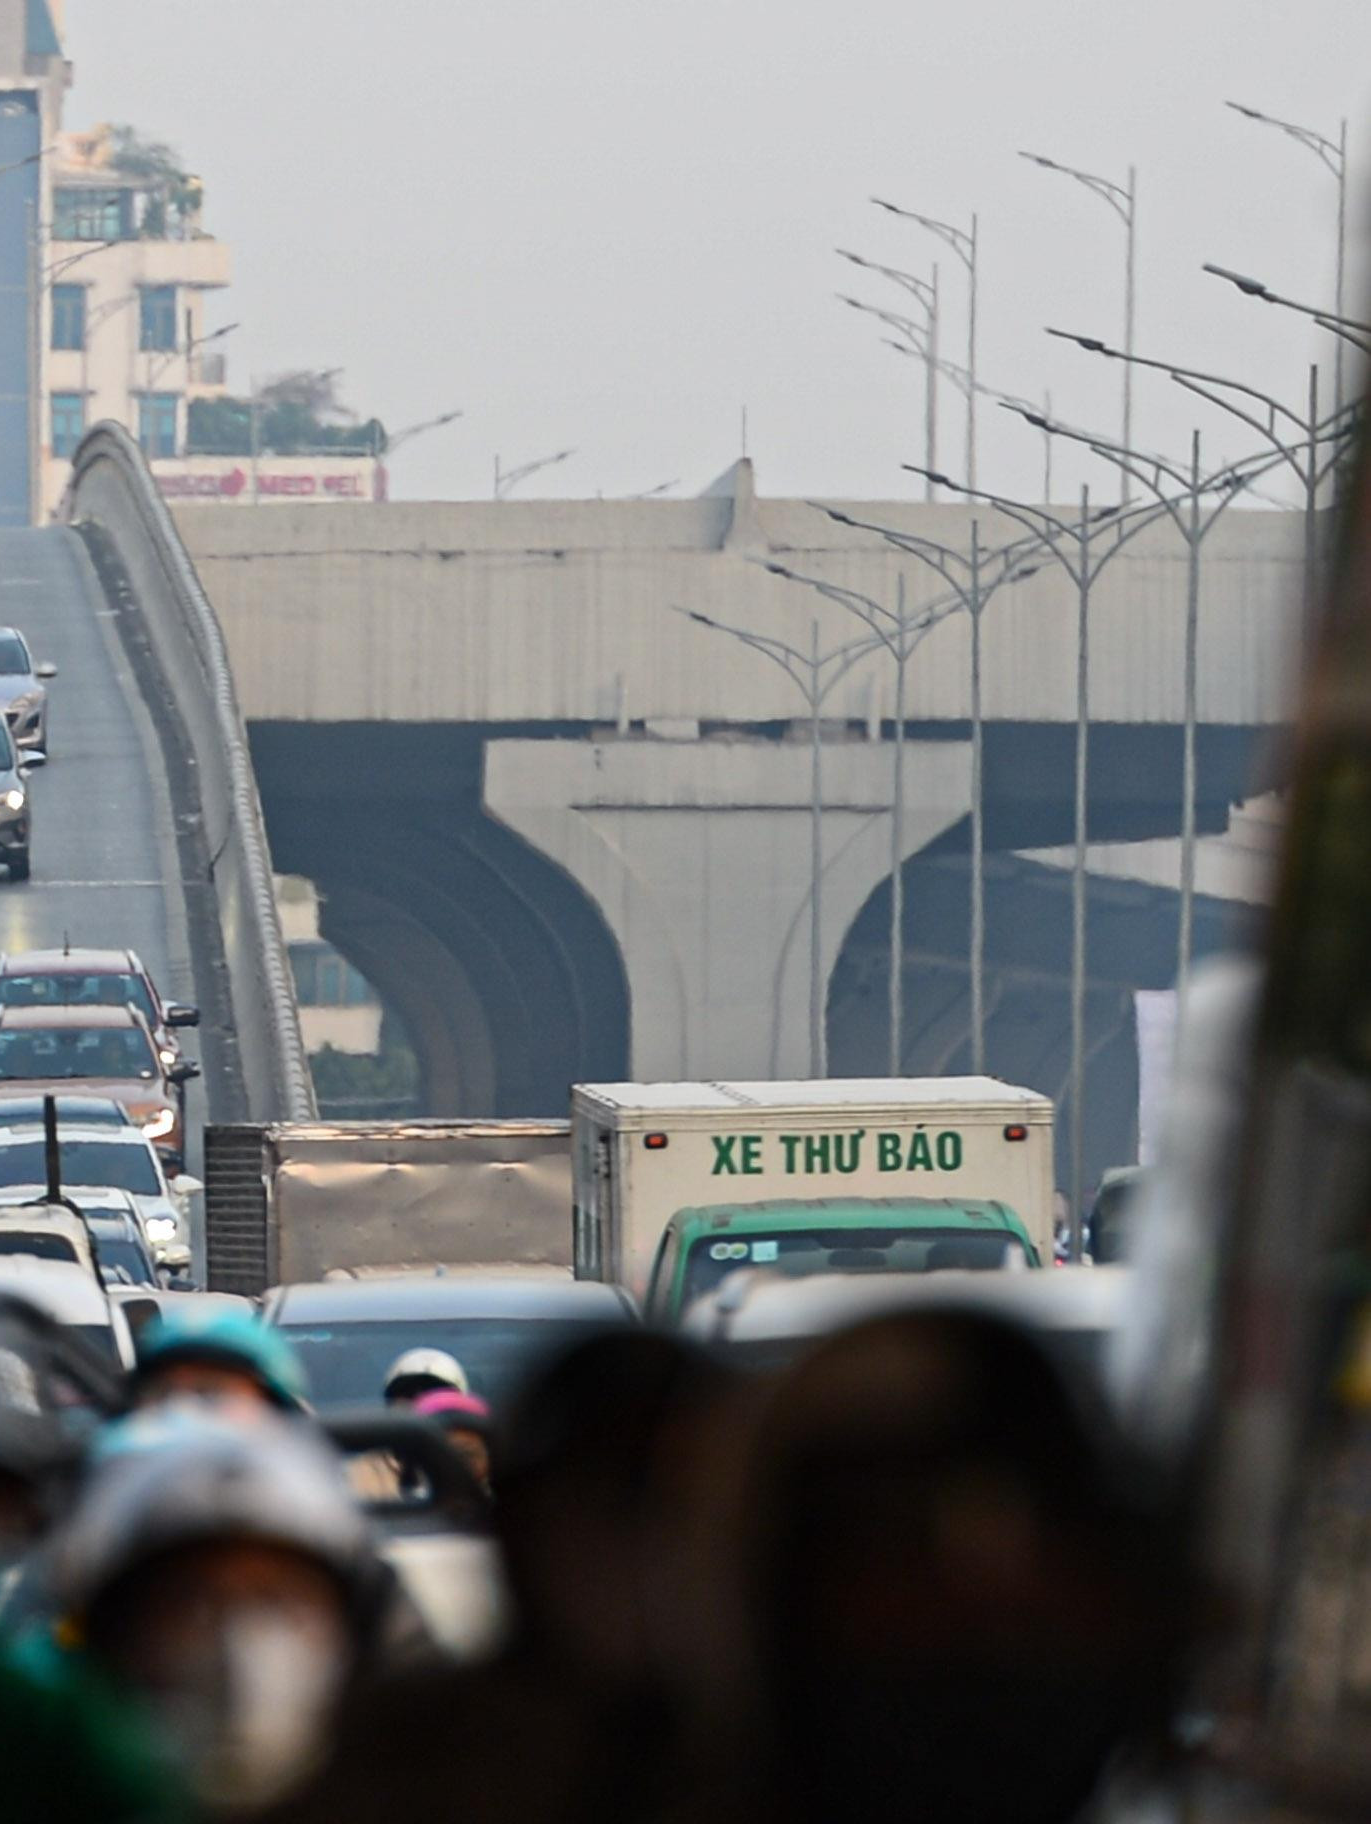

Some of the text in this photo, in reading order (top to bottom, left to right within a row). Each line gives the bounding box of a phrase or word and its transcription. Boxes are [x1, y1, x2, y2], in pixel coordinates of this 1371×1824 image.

[711, 1123, 963, 1175] XE THƯ BÁO
